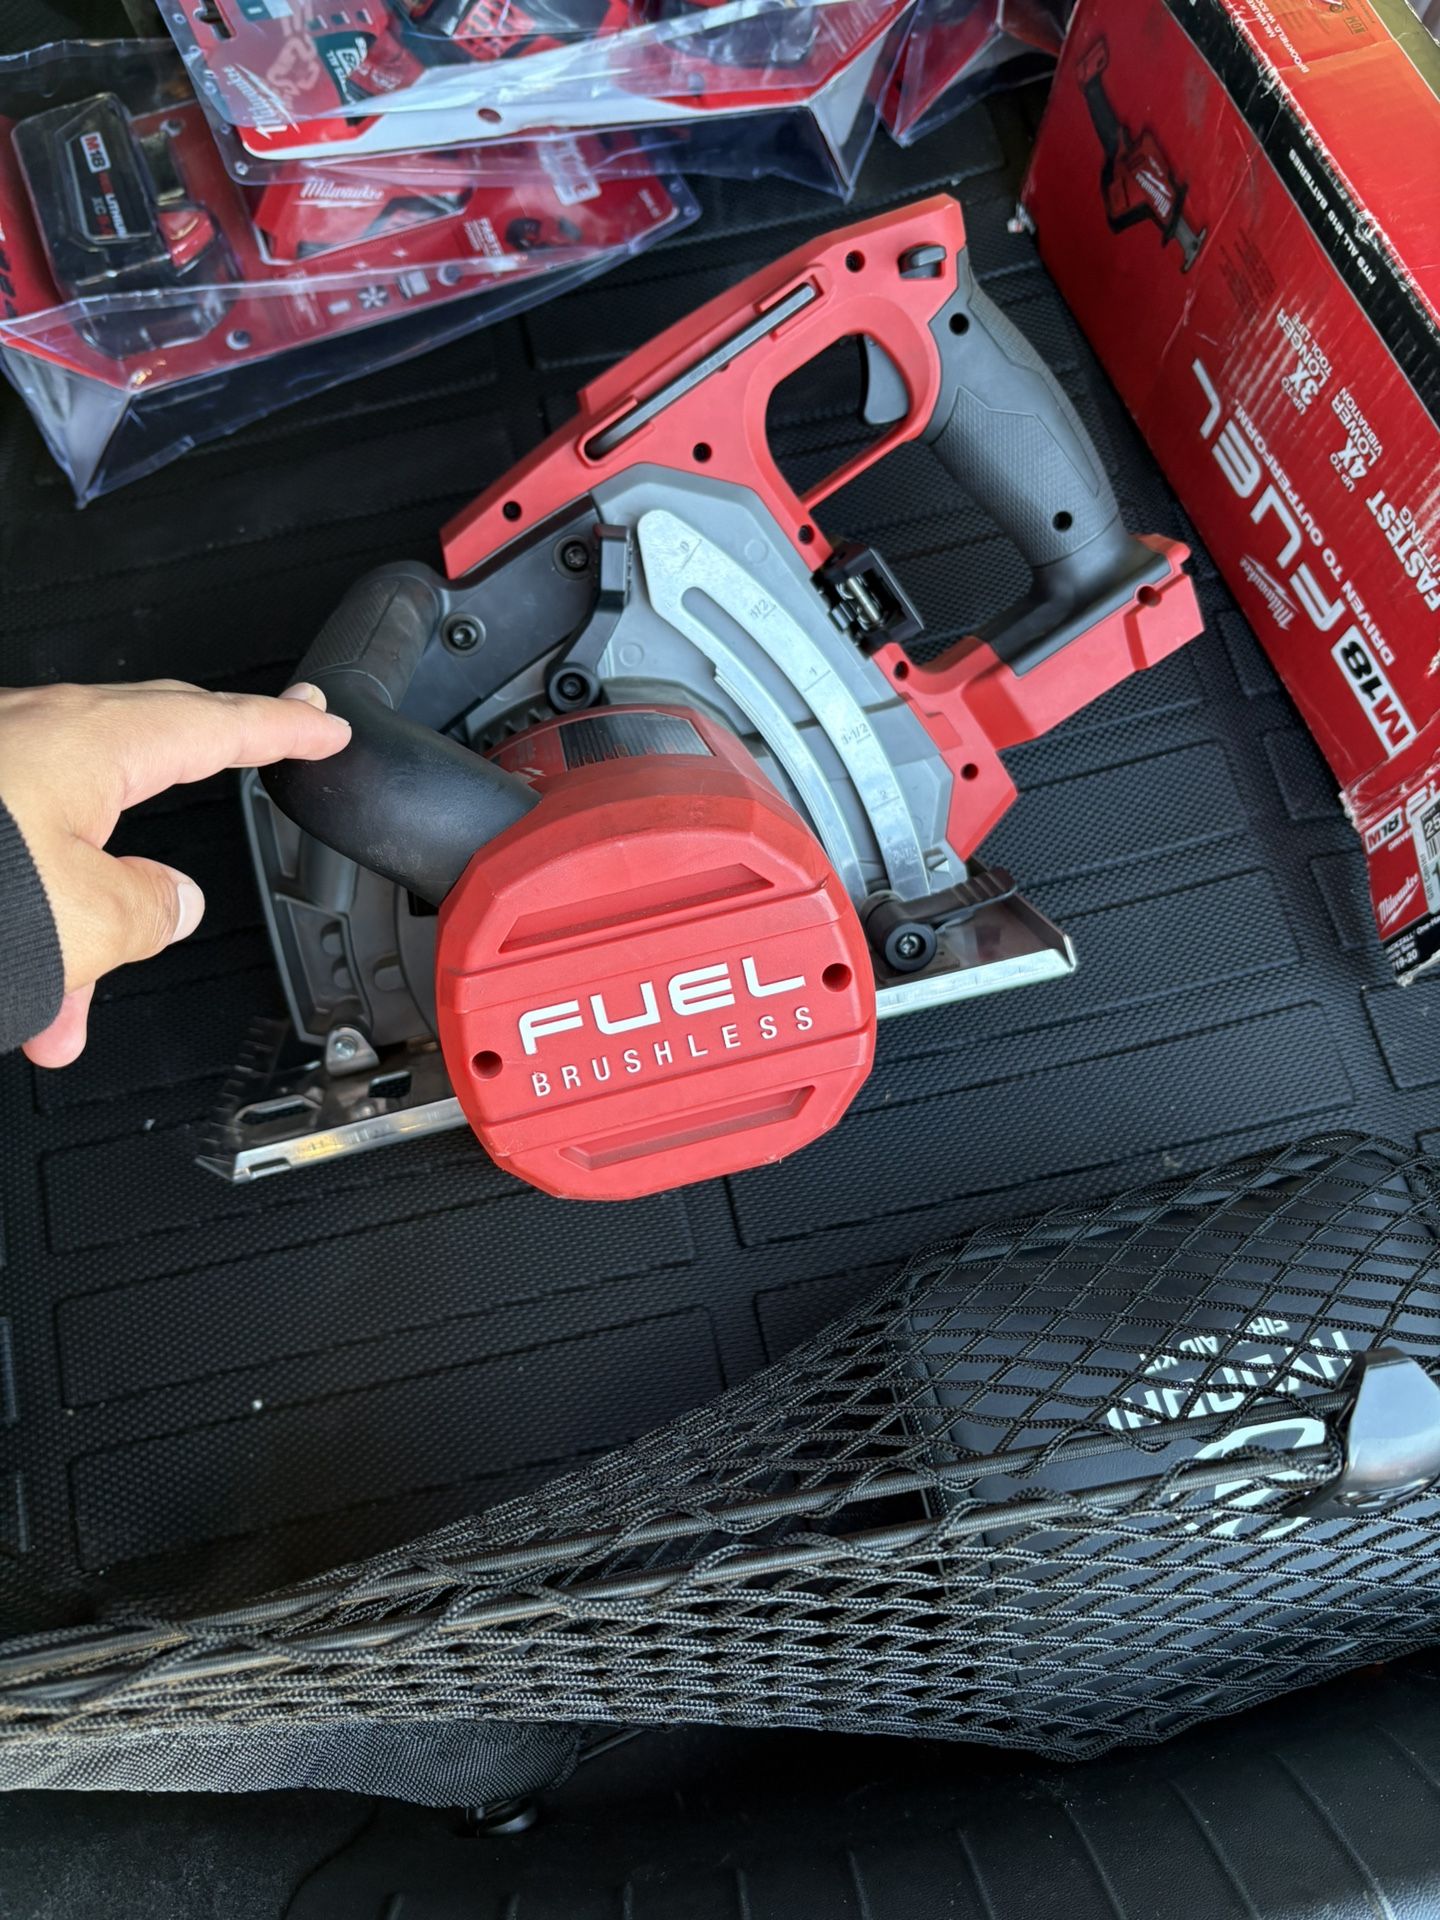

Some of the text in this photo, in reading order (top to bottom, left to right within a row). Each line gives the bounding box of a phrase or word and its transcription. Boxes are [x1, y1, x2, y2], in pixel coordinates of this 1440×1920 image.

[300, 176, 384, 200] Milwaukee
[1289, 148, 1377, 285] FITS ALL M18 BATTERIES
[1276, 307, 1329, 389] LONGER
[1291, 312, 1333, 377] TOOL LIFE
[1281, 377, 1306, 417] UP TO
[1289, 360, 1319, 405] 3X
[1331, 395, 1378, 467] LOWER
[1338, 437, 1367, 479] 4X
[1339, 387, 1383, 457] VIBRATION
[1192, 358, 1346, 631] FUEL
[1329, 452, 1356, 493] UP TO
[1322, 548, 1344, 582] TO
[1365, 490, 1440, 612] FASTEST
[1239, 556, 1296, 632] Milwaukee
[1341, 580, 1395, 667] DRIVEN
[1340, 641, 1410, 748] M18
[1377, 873, 1419, 925] Milwaukee
[519, 956, 807, 1055] FUEL
[531, 1006, 815, 1099] BRUSHLESS
